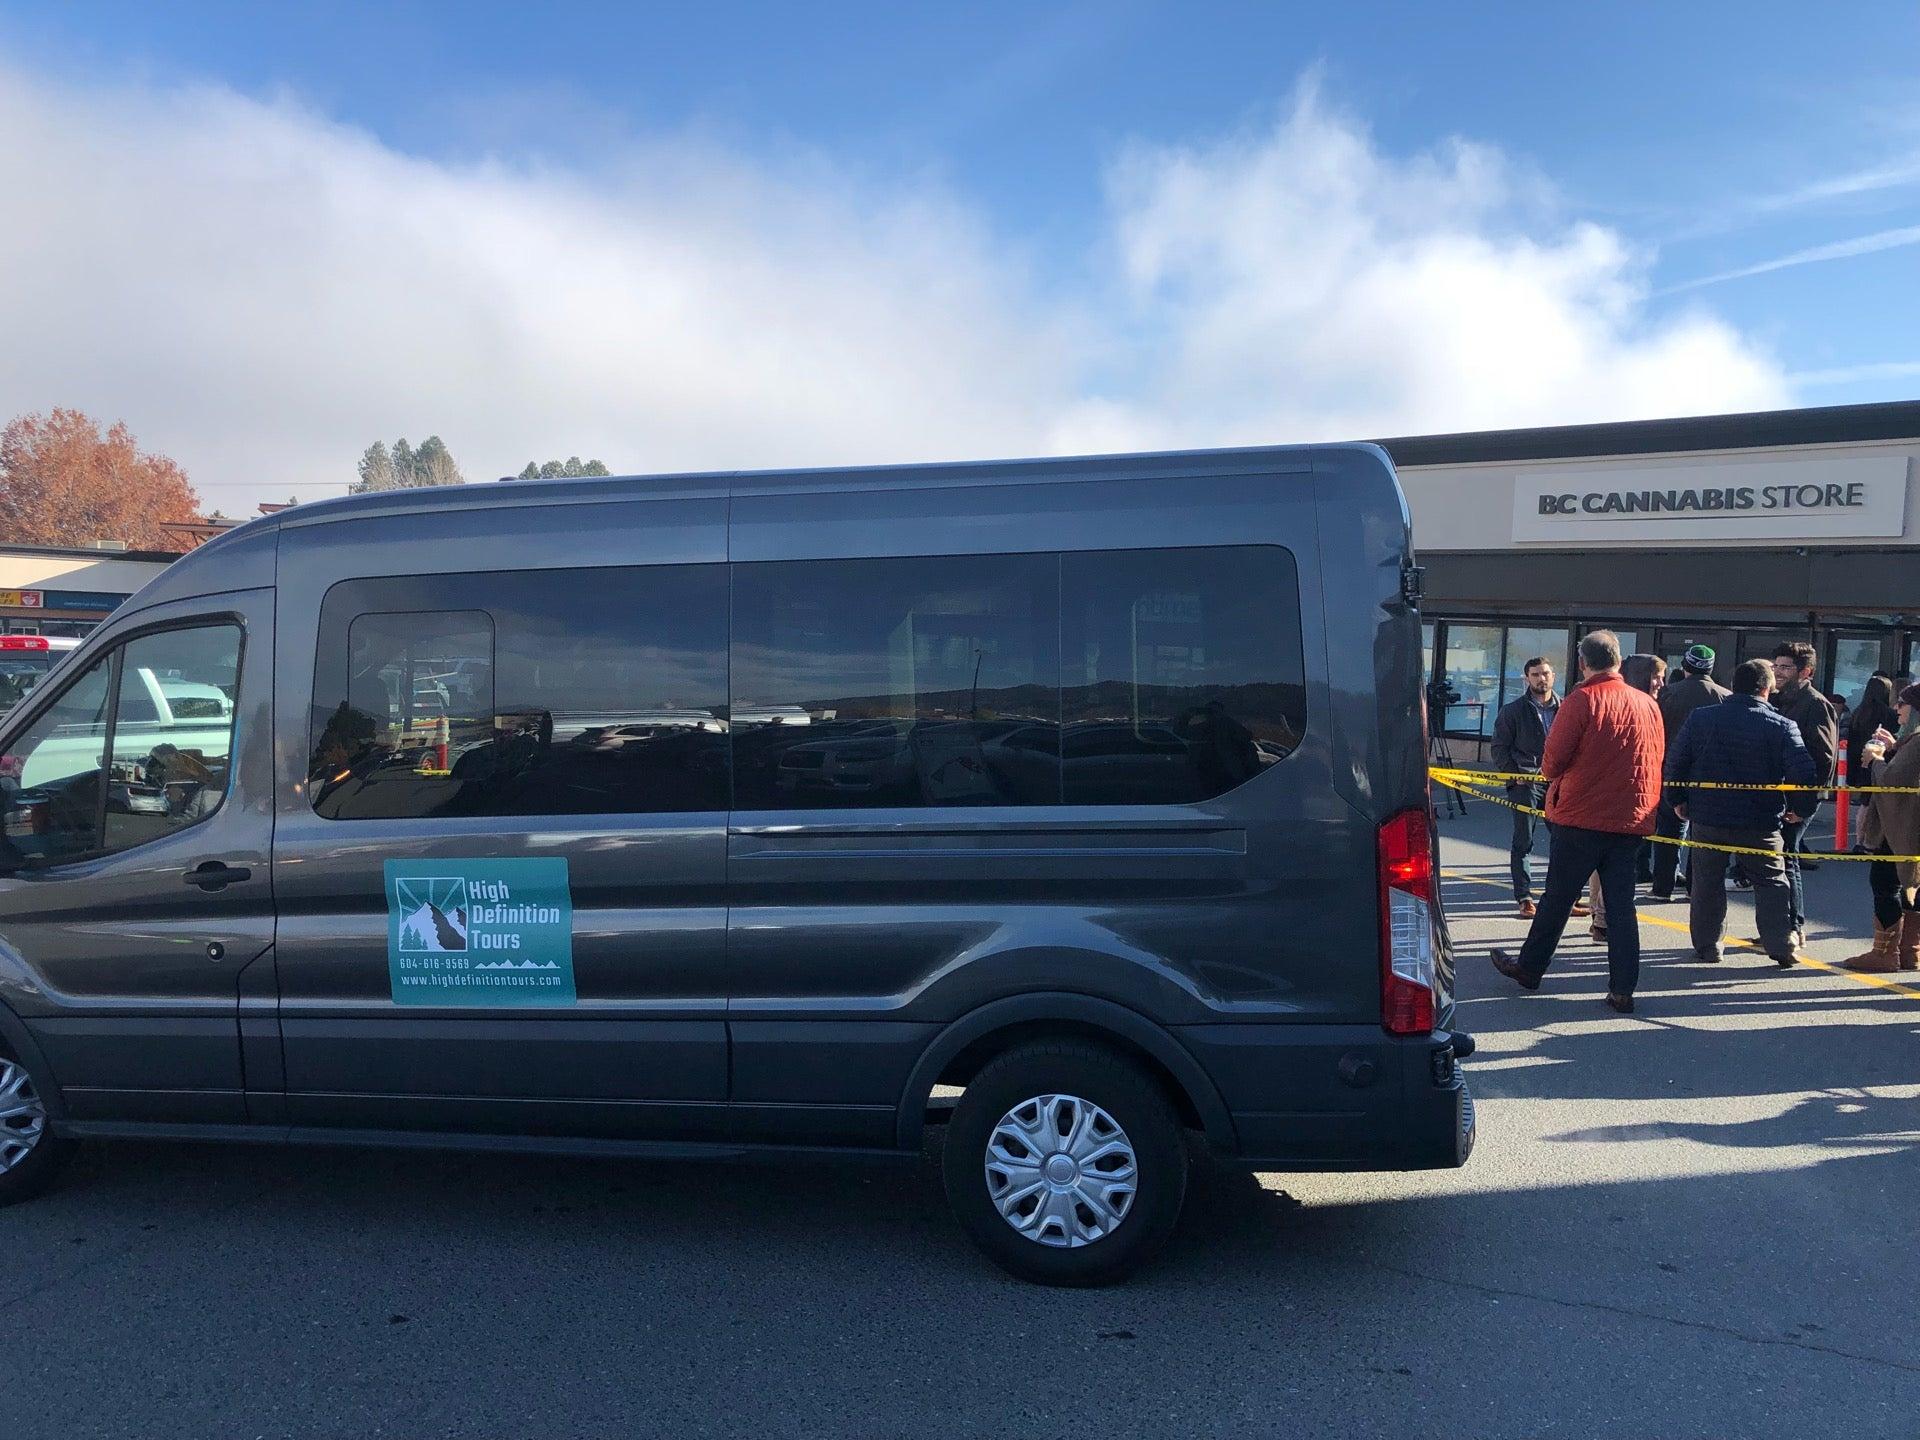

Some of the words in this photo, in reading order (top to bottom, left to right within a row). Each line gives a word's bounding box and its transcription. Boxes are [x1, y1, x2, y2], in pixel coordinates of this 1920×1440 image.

[1538, 494, 1577, 515] BC
[1581, 486, 1755, 514] CANNABIS
[1761, 482, 1864, 508] STORE
[469, 880, 510, 902] High
[472, 903, 560, 924] Definition
[471, 930, 521, 949] Tours
[399, 958, 470, 969] 604-616-9569
[401, 973, 561, 988] www.highdefinitiontours.com
